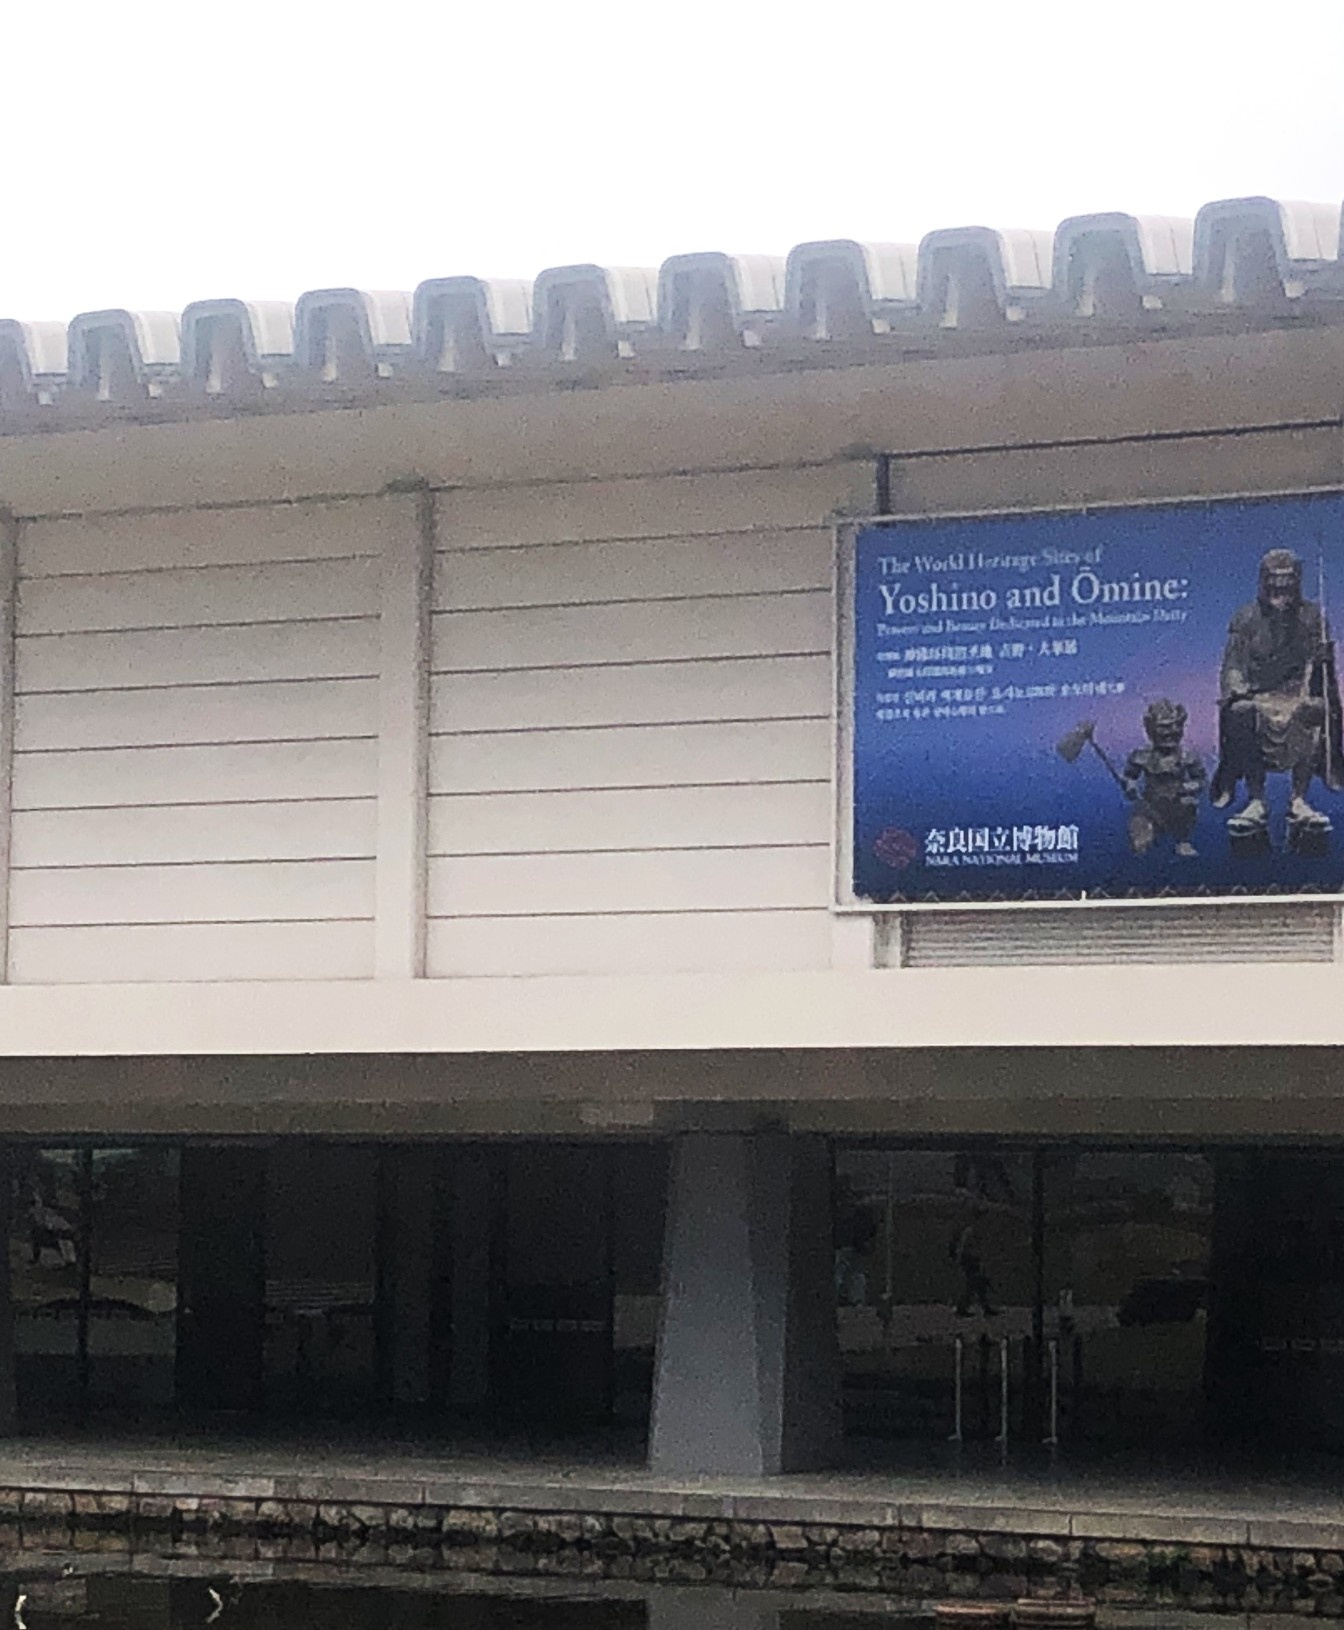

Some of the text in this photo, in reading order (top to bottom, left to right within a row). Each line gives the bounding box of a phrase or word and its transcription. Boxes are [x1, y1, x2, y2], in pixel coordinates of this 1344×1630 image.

[878, 556, 910, 576] The
[914, 553, 964, 574] World
[968, 552, 1038, 574] Heritage
[879, 566, 1189, 616] Yoshino and Ōmine:
[924, 825, 1079, 854] 奈良国立博物館
